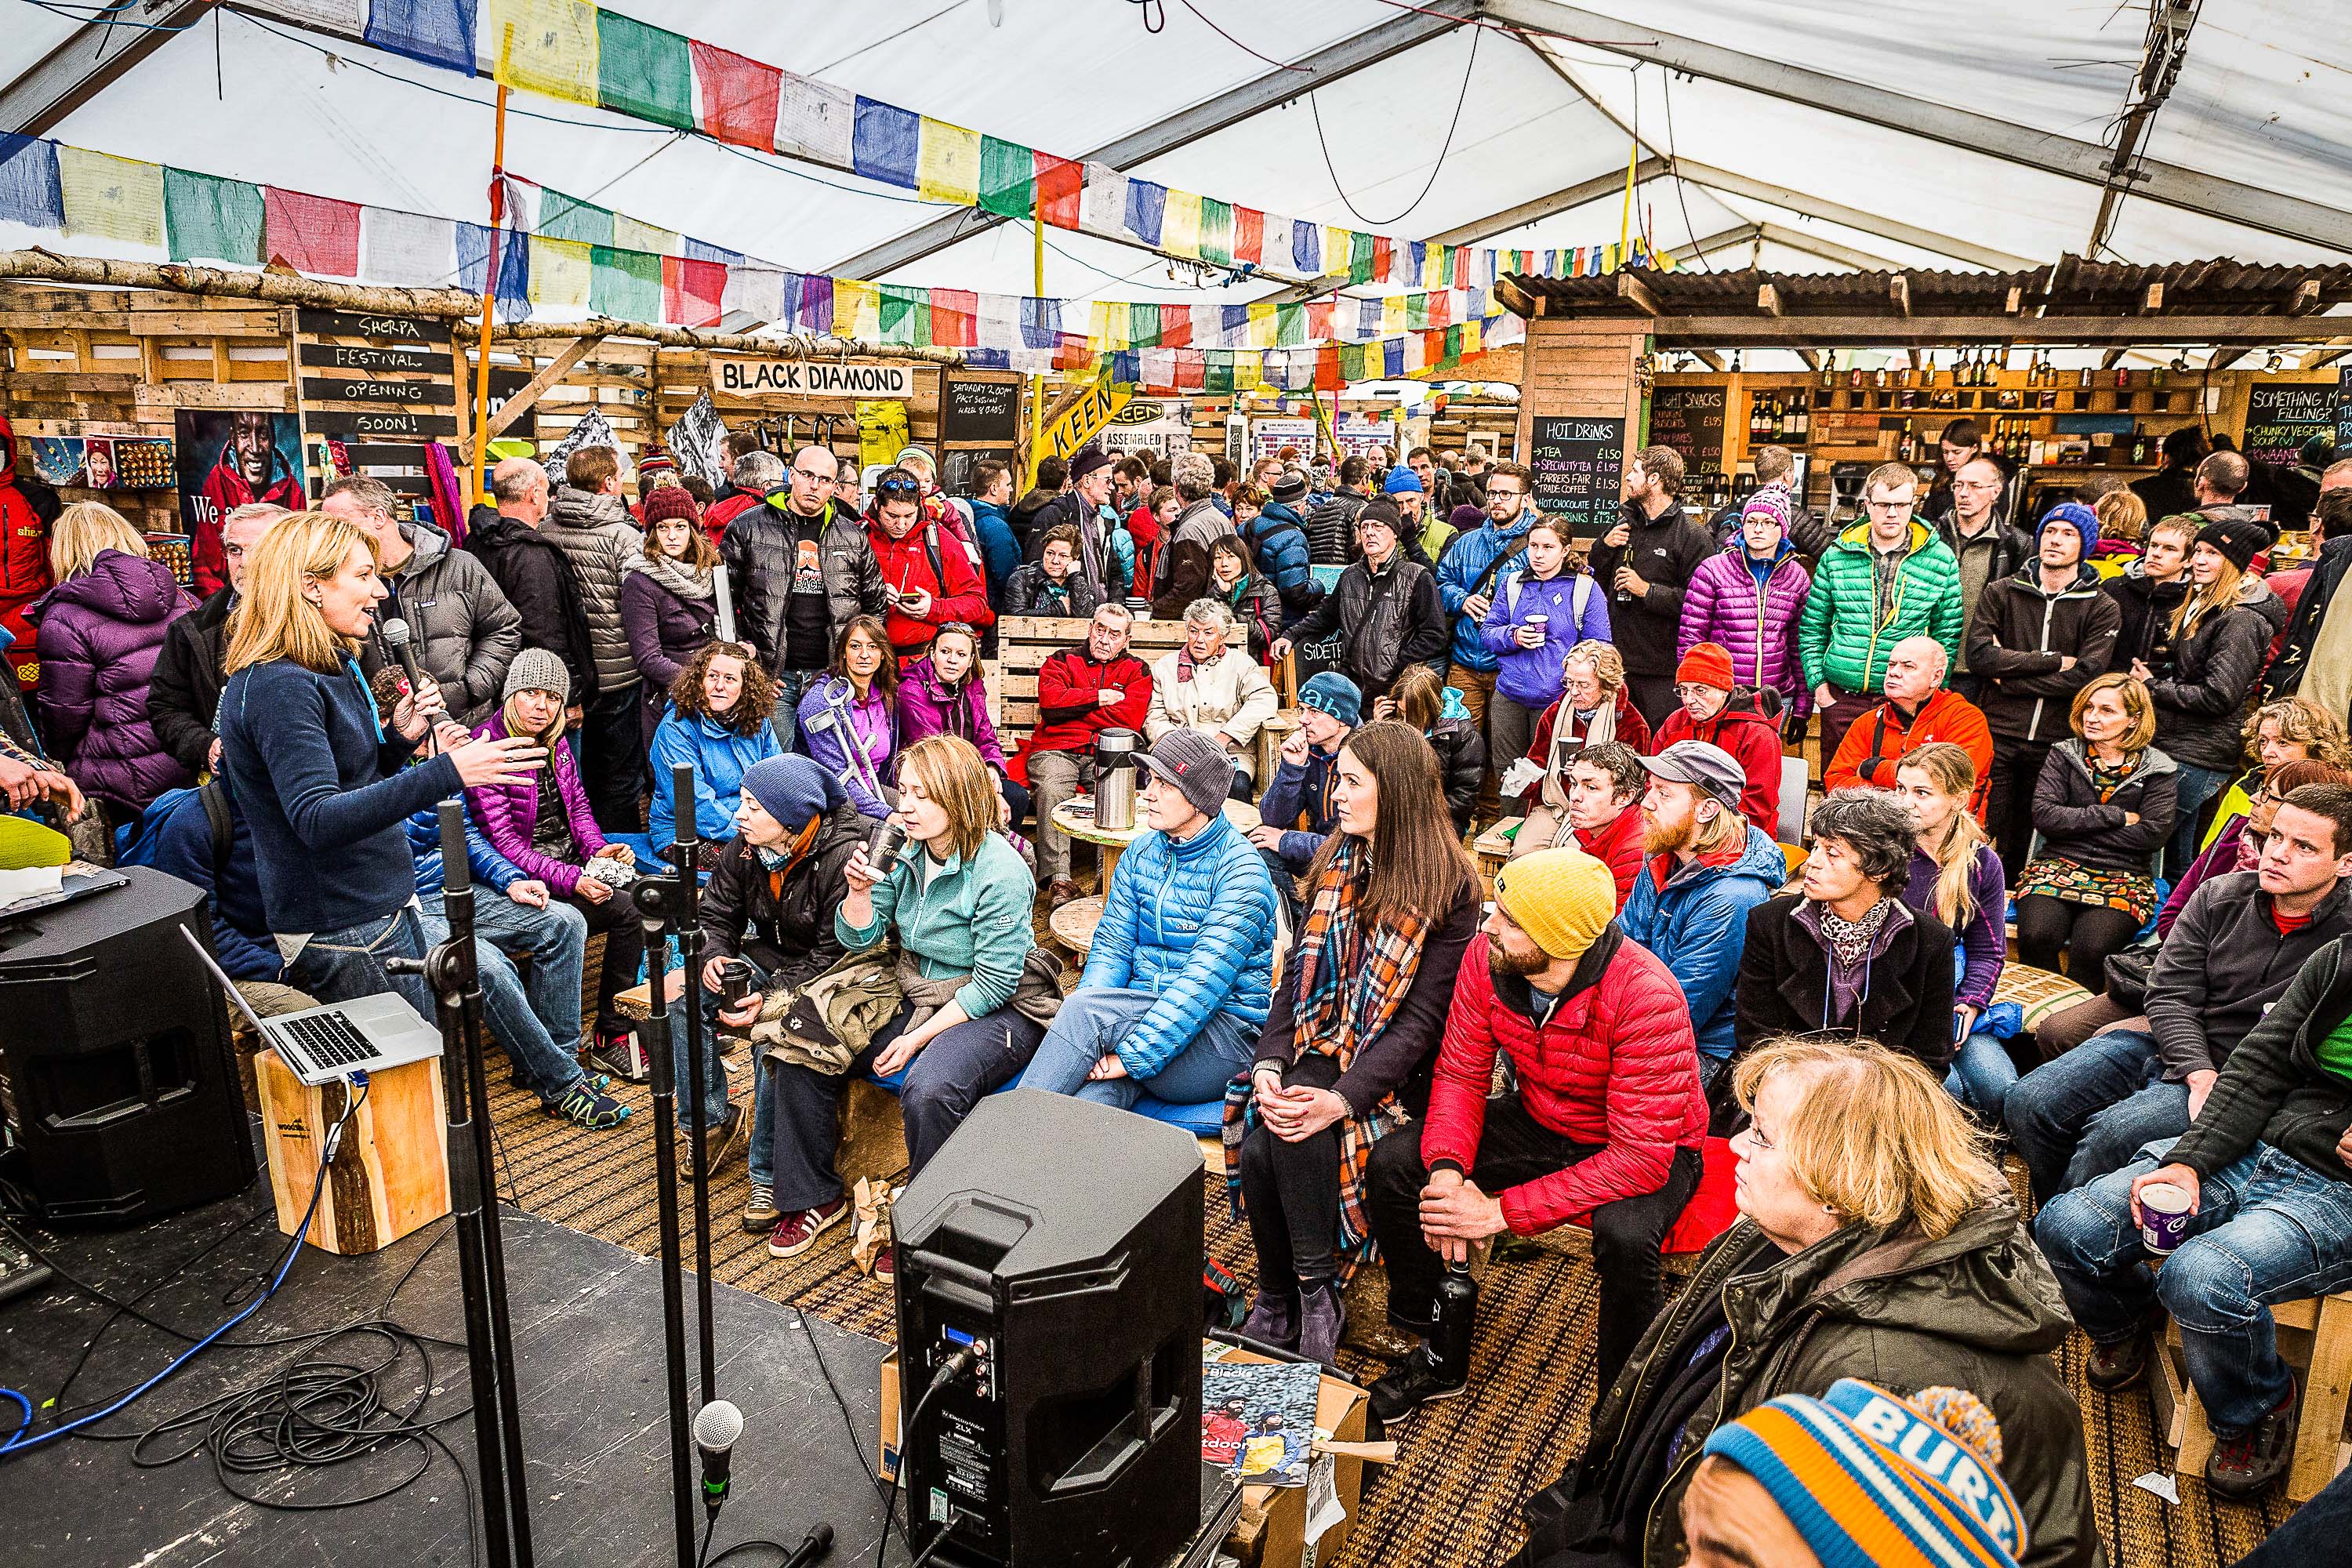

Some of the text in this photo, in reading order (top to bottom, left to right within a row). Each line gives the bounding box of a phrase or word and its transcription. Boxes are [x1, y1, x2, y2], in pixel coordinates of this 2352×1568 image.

[359, 317, 420, 337] SHERPA
[723, 364, 903, 391] BLACK DIAMOND
[346, 382, 422, 399] OPENING
[953, 383, 986, 394] SATURDAY
[1685, 392, 1722, 408] SNACKS
[2253, 390, 2322, 408] SOMETHING
[357, 416, 418, 432] SOON!
[1053, 379, 1113, 457] KEEN
[1547, 423, 1573, 438] HOT
[2253, 426, 2289, 437] CHUNKY
[1106, 433, 1160, 445] ASSEMBLED
[2252, 437, 2278, 446] SOUP
[1542, 446, 1621, 459] TEA £1.50
[1577, 461, 1592, 472] TEA
[1596, 461, 1619, 472] £1.95
[1540, 473, 1570, 484] FARRERS
[1596, 477, 1620, 489] £1.50
[1537, 485, 1588, 494] TRADE COFFEE
[191, 495, 219, 524] We
[1538, 498, 1618, 510] HOT CHOCOLATE £1.50
[1594, 514, 1616, 524] £1.25
[1181, 923, 1199, 931] Rab
[1210, 1368, 1253, 1377] Blacks
[955, 1422, 971, 1435] ZLX
